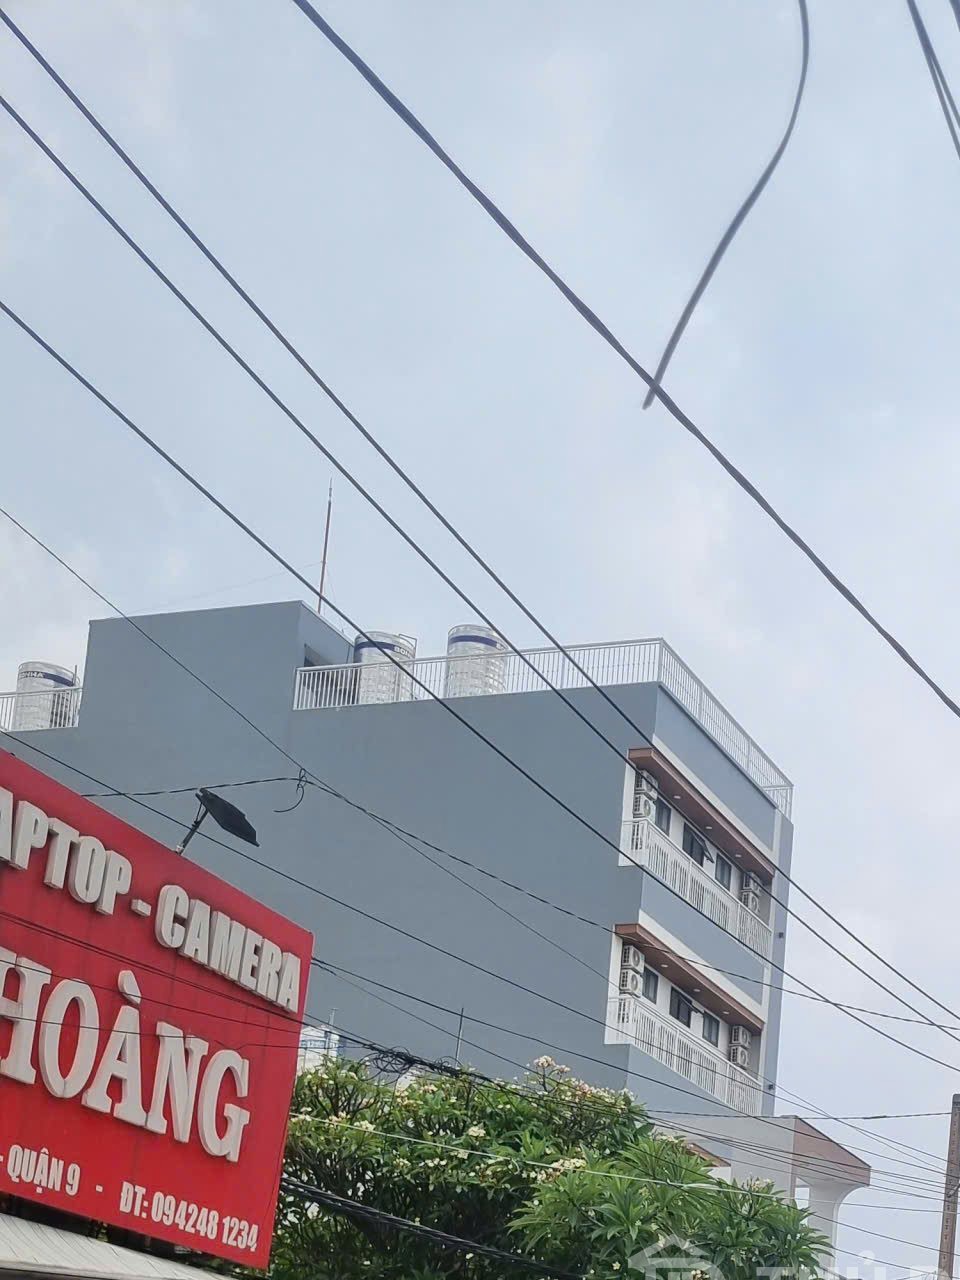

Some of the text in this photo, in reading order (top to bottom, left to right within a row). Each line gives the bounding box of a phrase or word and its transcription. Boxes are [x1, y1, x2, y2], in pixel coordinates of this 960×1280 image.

[155, 885, 300, 1014] CAMERA
[0, 950, 250, 1162] HOÀNG
[7, 1144, 64, 1194] QUẬN
[65, 1163, 81, 1196] 9
[119, 1181, 149, 1219] ĐT:
[151, 1191, 219, 1240] 094248
[222, 1215, 259, 1252] 1234
